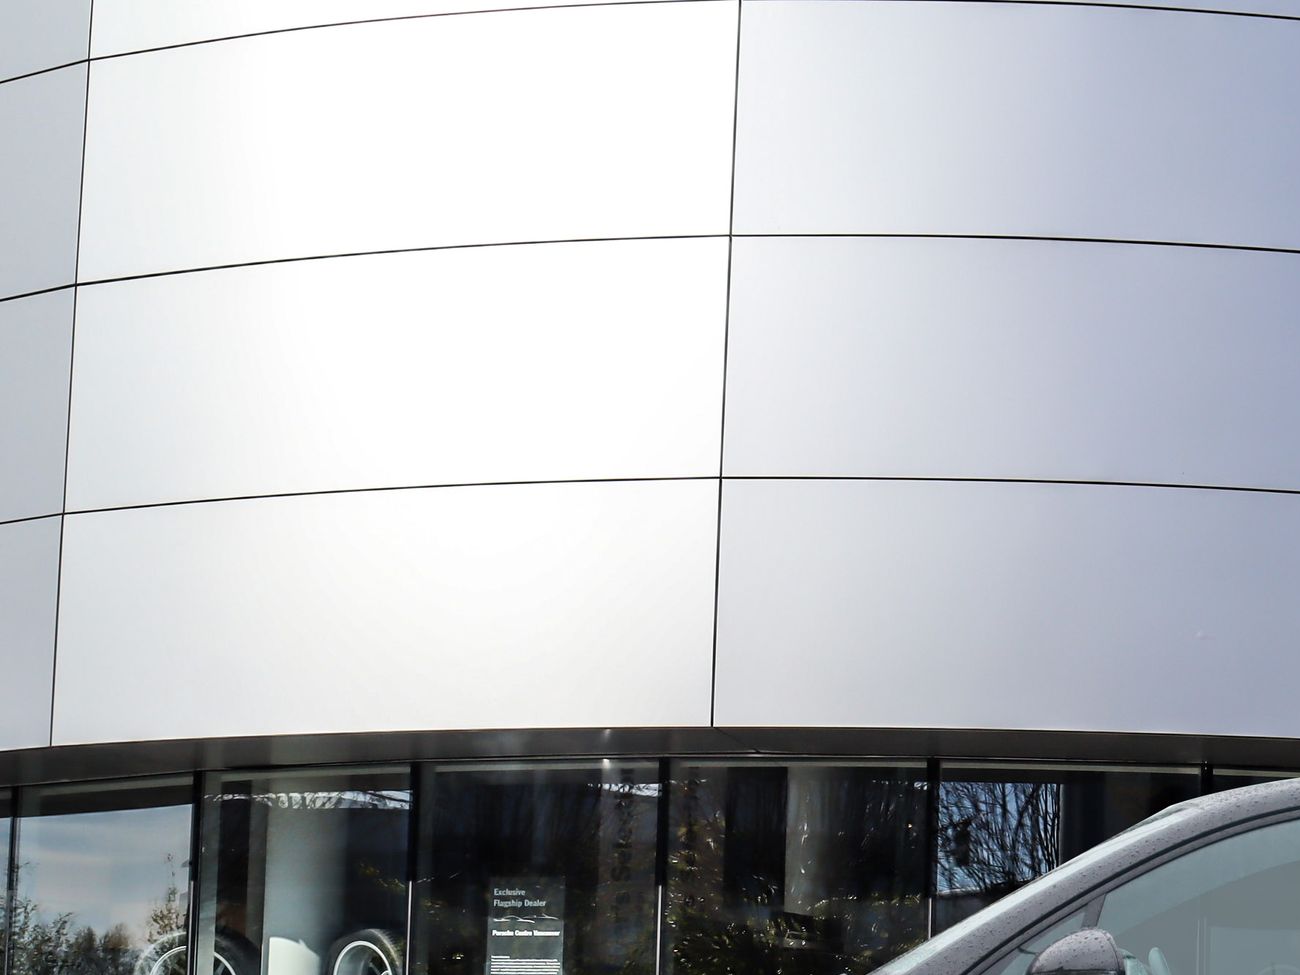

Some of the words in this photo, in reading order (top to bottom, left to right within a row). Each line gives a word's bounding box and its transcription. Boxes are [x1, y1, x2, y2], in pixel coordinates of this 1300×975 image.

[493, 887, 526, 896] Exclusive
[493, 899, 523, 908] Flagship
[524, 899, 547, 907] Dealer
